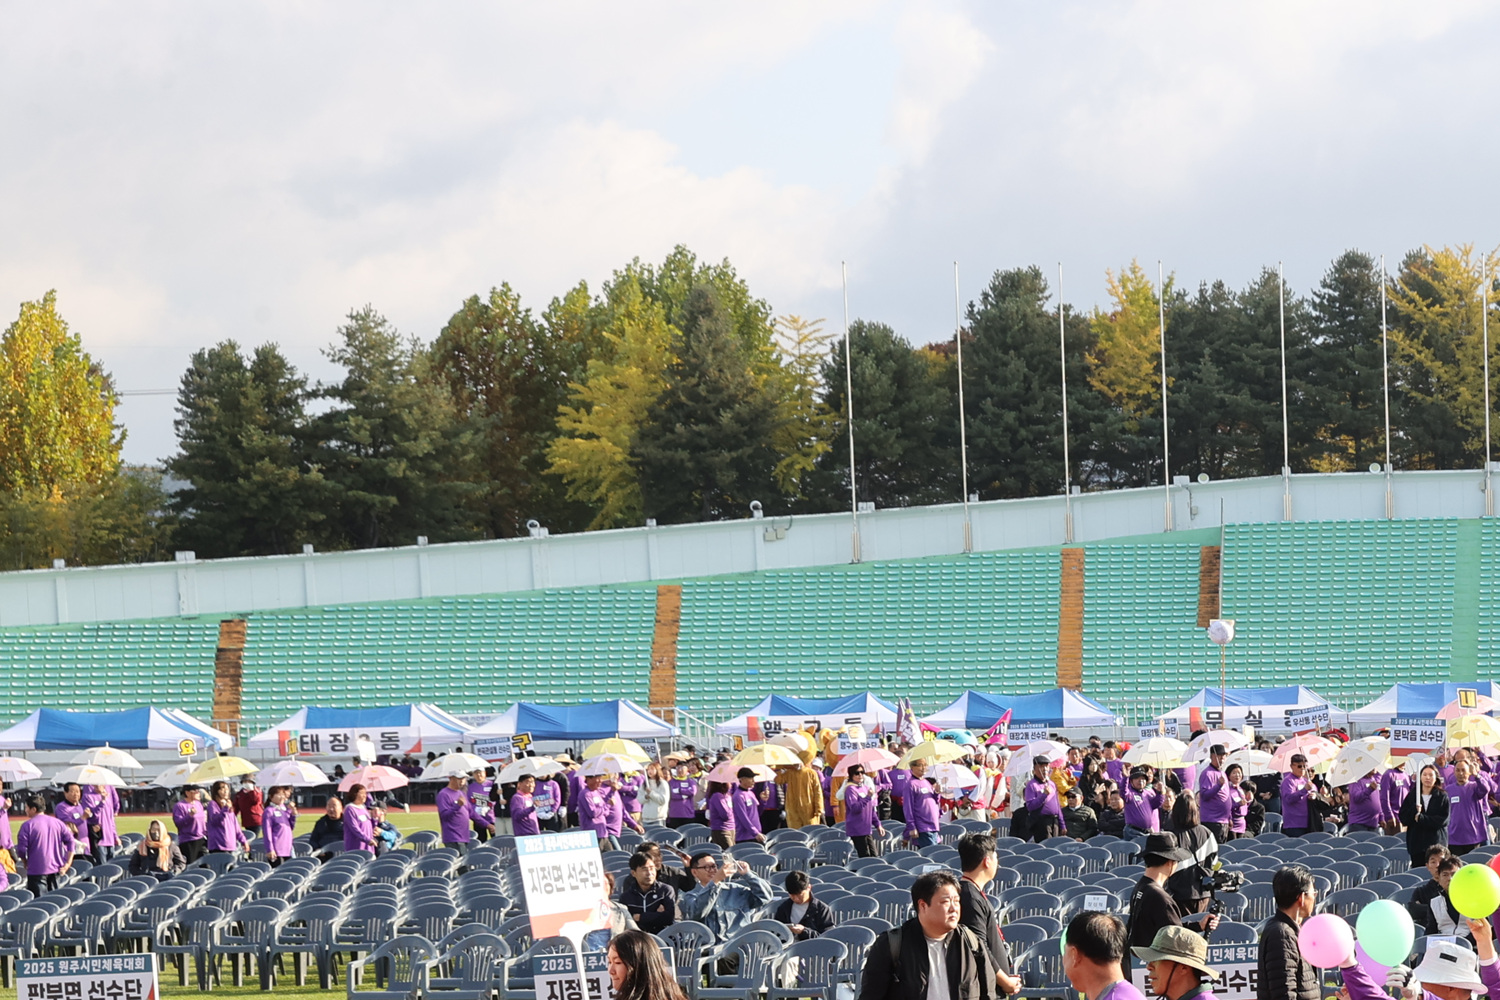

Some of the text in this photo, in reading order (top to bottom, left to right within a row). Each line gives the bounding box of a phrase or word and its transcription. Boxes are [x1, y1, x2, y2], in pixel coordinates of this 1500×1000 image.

[300, 732, 400, 754] 태장동
[1031, 731, 1047, 740] 선수단
[1394, 729, 1443, 743] 문막읍 선수단
[528, 860, 601, 895] 지정면 선수단
[23, 957, 145, 975] 2025 원주시민체육대회
[541, 957, 573, 972] 2025
